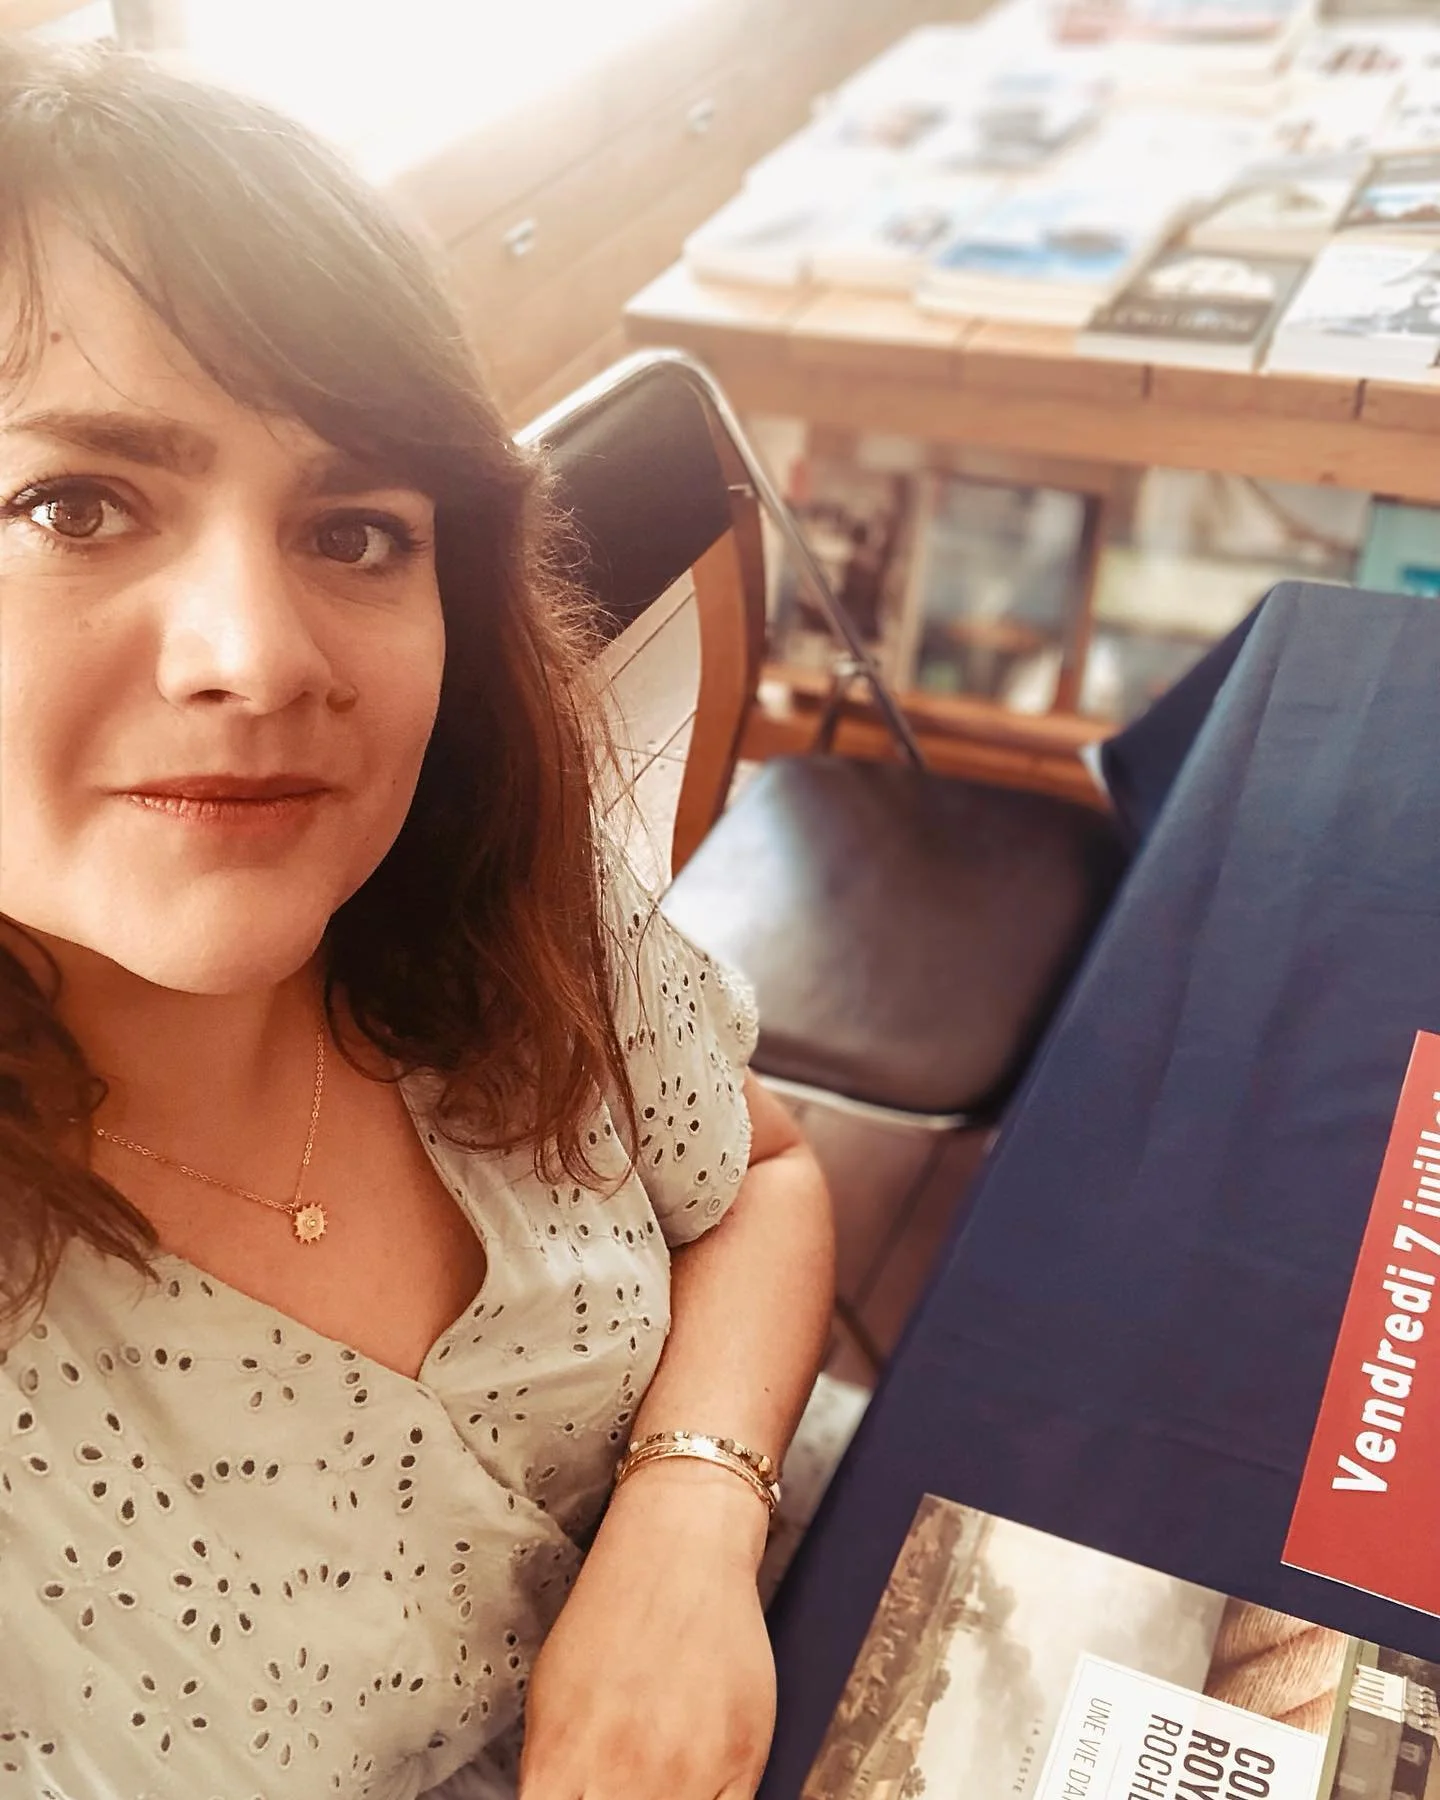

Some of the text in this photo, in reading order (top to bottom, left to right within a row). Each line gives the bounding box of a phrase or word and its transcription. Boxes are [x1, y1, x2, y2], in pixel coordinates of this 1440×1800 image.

[1331, 1264, 1437, 1492] Vendredi
[1393, 1224, 1440, 1256] 7
[1012, 1745, 1035, 1793] GESTE
[1061, 1697, 1113, 1800] UNE VIE D'A
[1174, 1729, 1231, 1800] ROY
[1225, 1747, 1276, 1800] CO
